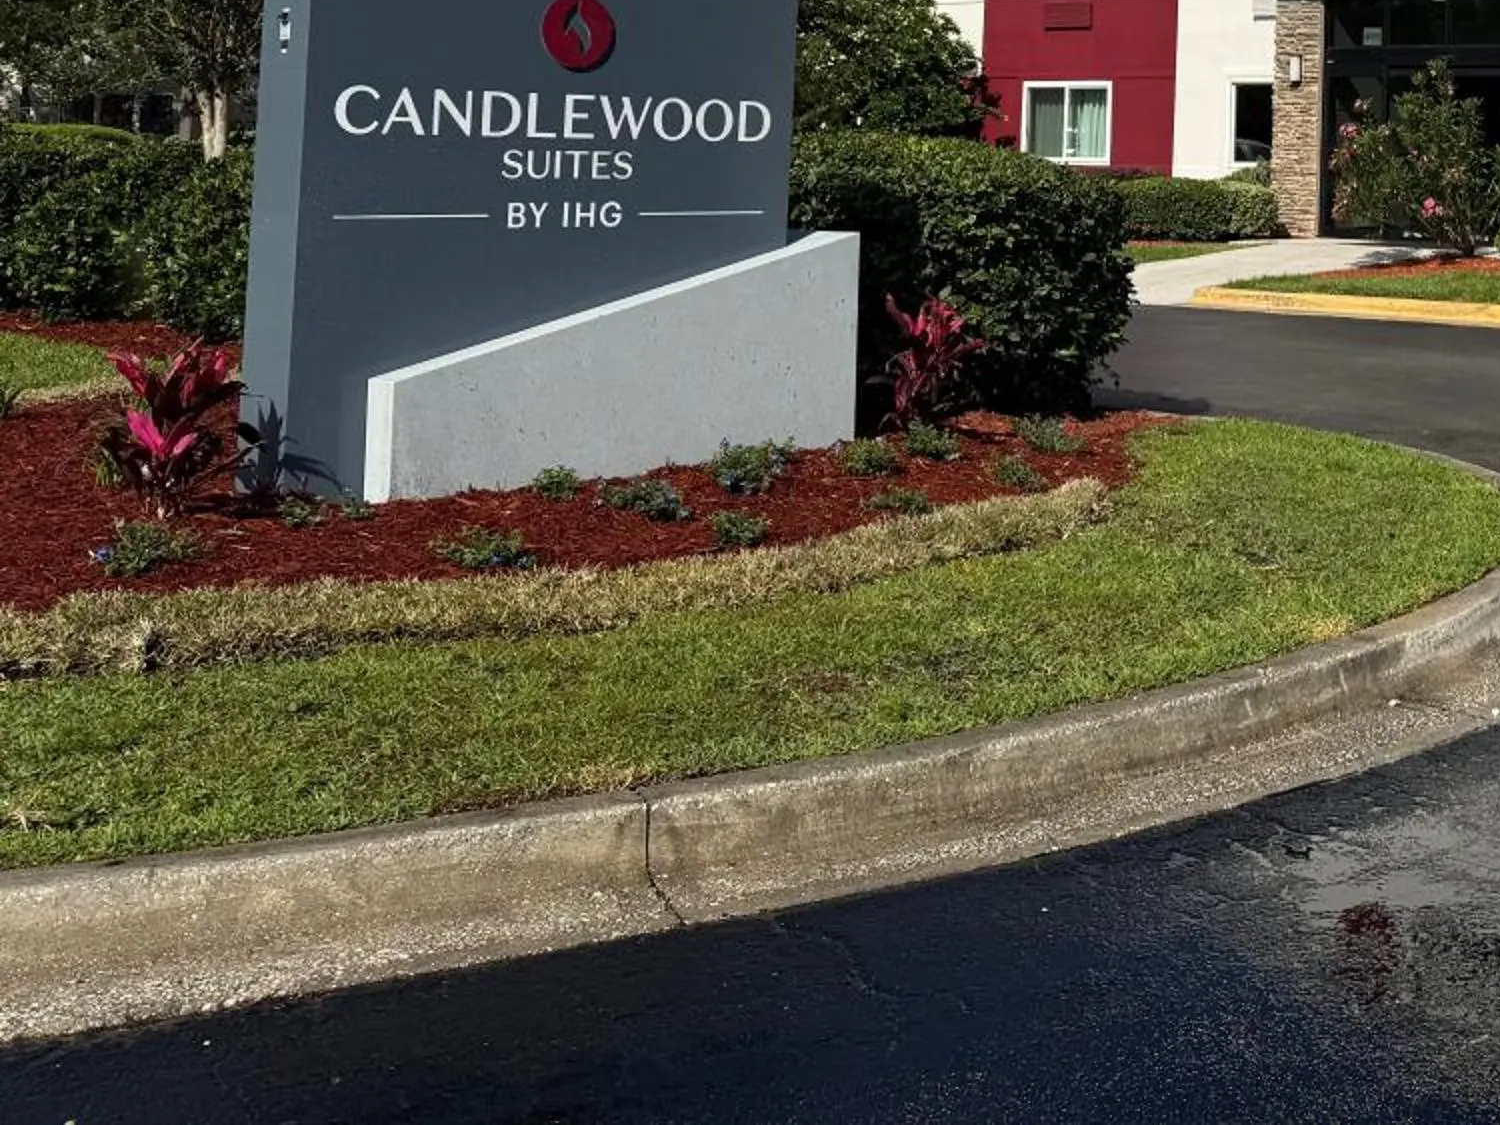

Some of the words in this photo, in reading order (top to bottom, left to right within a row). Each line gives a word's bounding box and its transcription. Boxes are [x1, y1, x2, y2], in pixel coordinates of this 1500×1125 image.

[334, 84, 772, 142] CANDLEWOOD
[501, 149, 633, 180] SUITES
[507, 202, 549, 229] BY
[562, 200, 623, 228] IHG
